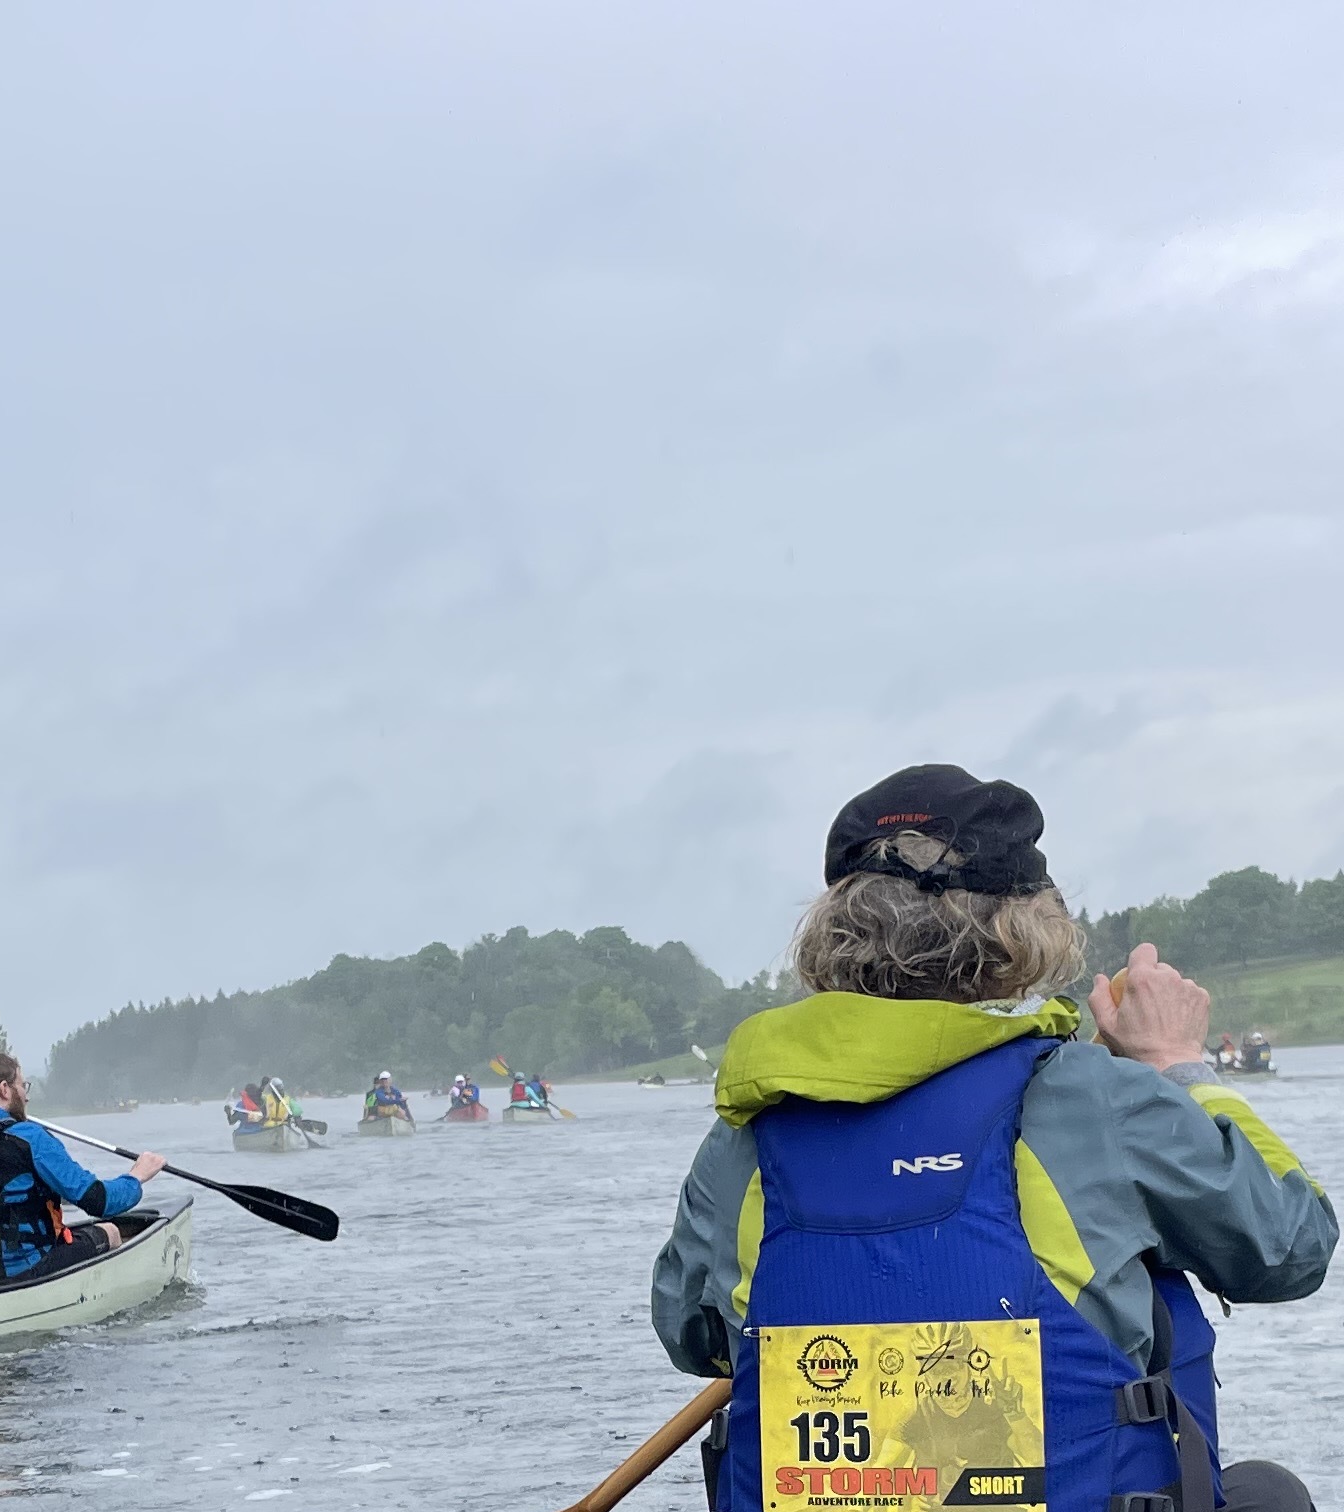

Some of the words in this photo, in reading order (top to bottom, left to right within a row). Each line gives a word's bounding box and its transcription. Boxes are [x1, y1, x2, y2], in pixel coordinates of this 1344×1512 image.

[892, 1153, 963, 1176] NRS
[796, 1358, 859, 1370] STORM
[879, 1380, 904, 1399] Bike
[790, 1411, 871, 1463] 135
[775, 1467, 938, 1496] STORM
[969, 1475, 1025, 1496] SHORT
[807, 1497, 872, 1507] ADVENTURE
[874, 1496, 904, 1507] RACE
